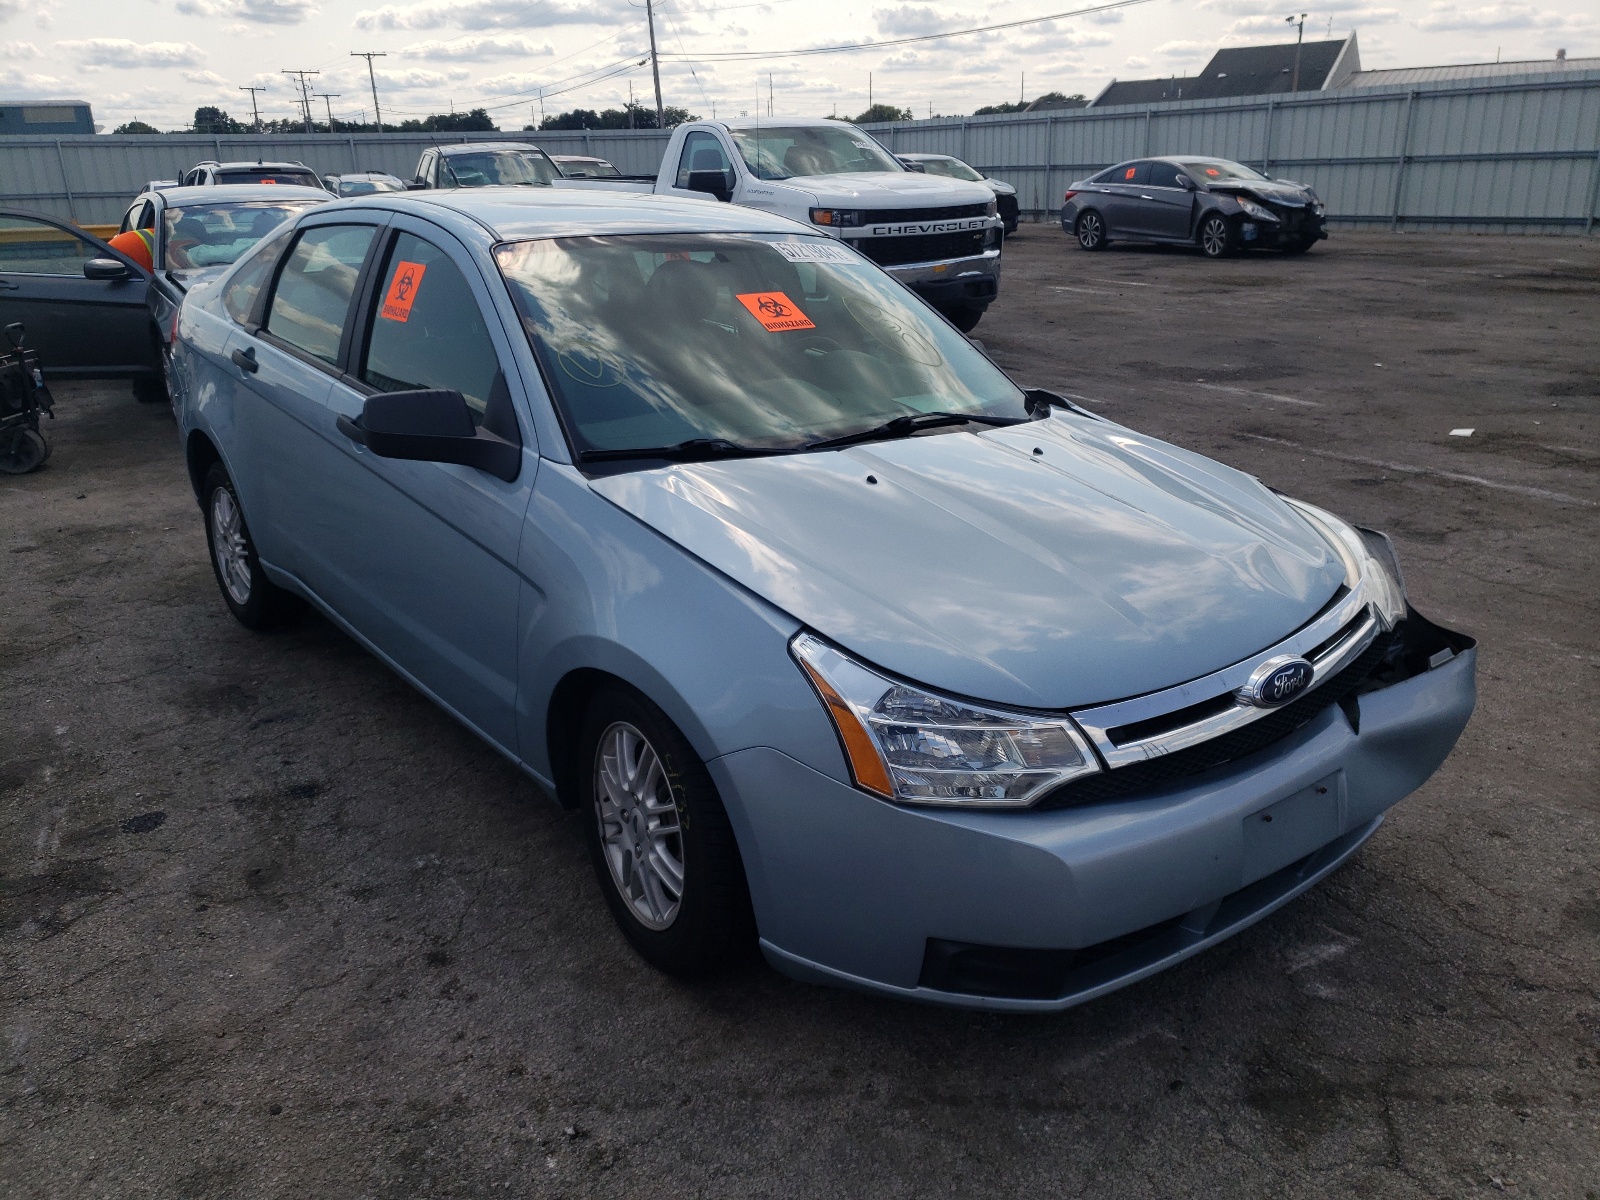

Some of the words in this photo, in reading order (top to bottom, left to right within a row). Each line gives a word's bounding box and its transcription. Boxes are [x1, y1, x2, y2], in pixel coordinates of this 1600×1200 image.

[873, 220, 987, 235] CHEVROLET
[764, 319, 812, 330] BIOHAZARD
[1274, 667, 1306, 699] Ford
